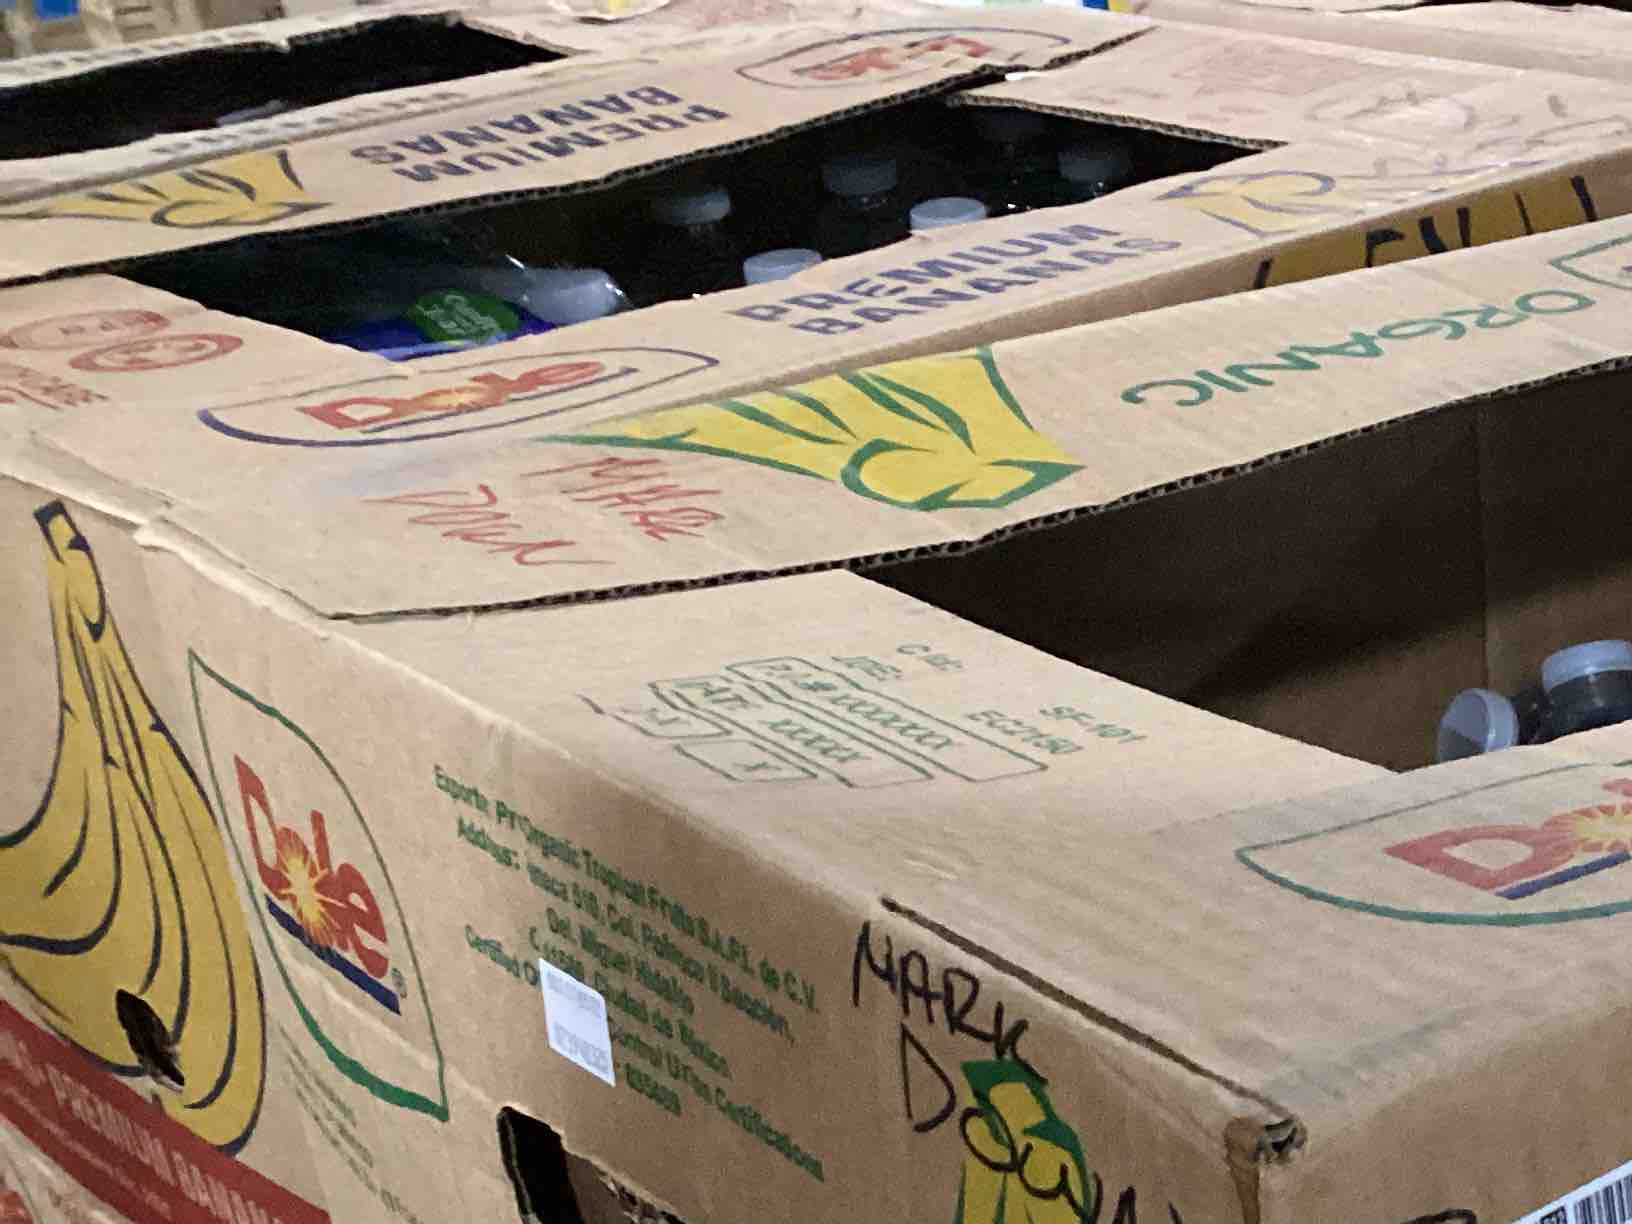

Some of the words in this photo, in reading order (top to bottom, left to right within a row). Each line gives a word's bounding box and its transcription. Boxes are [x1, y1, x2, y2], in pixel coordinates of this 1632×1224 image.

[349, 85, 684, 167] BANANAS
[393, 103, 731, 184] PREMIUM
[731, 221, 1121, 325] PREMIUM
[794, 235, 1184, 337] BANANAS
[303, 360, 604, 431] Dole
[1119, 288, 1596, 409] ORGANIC
[233, 754, 390, 981] Dole
[852, 920, 1049, 1087] MARK
